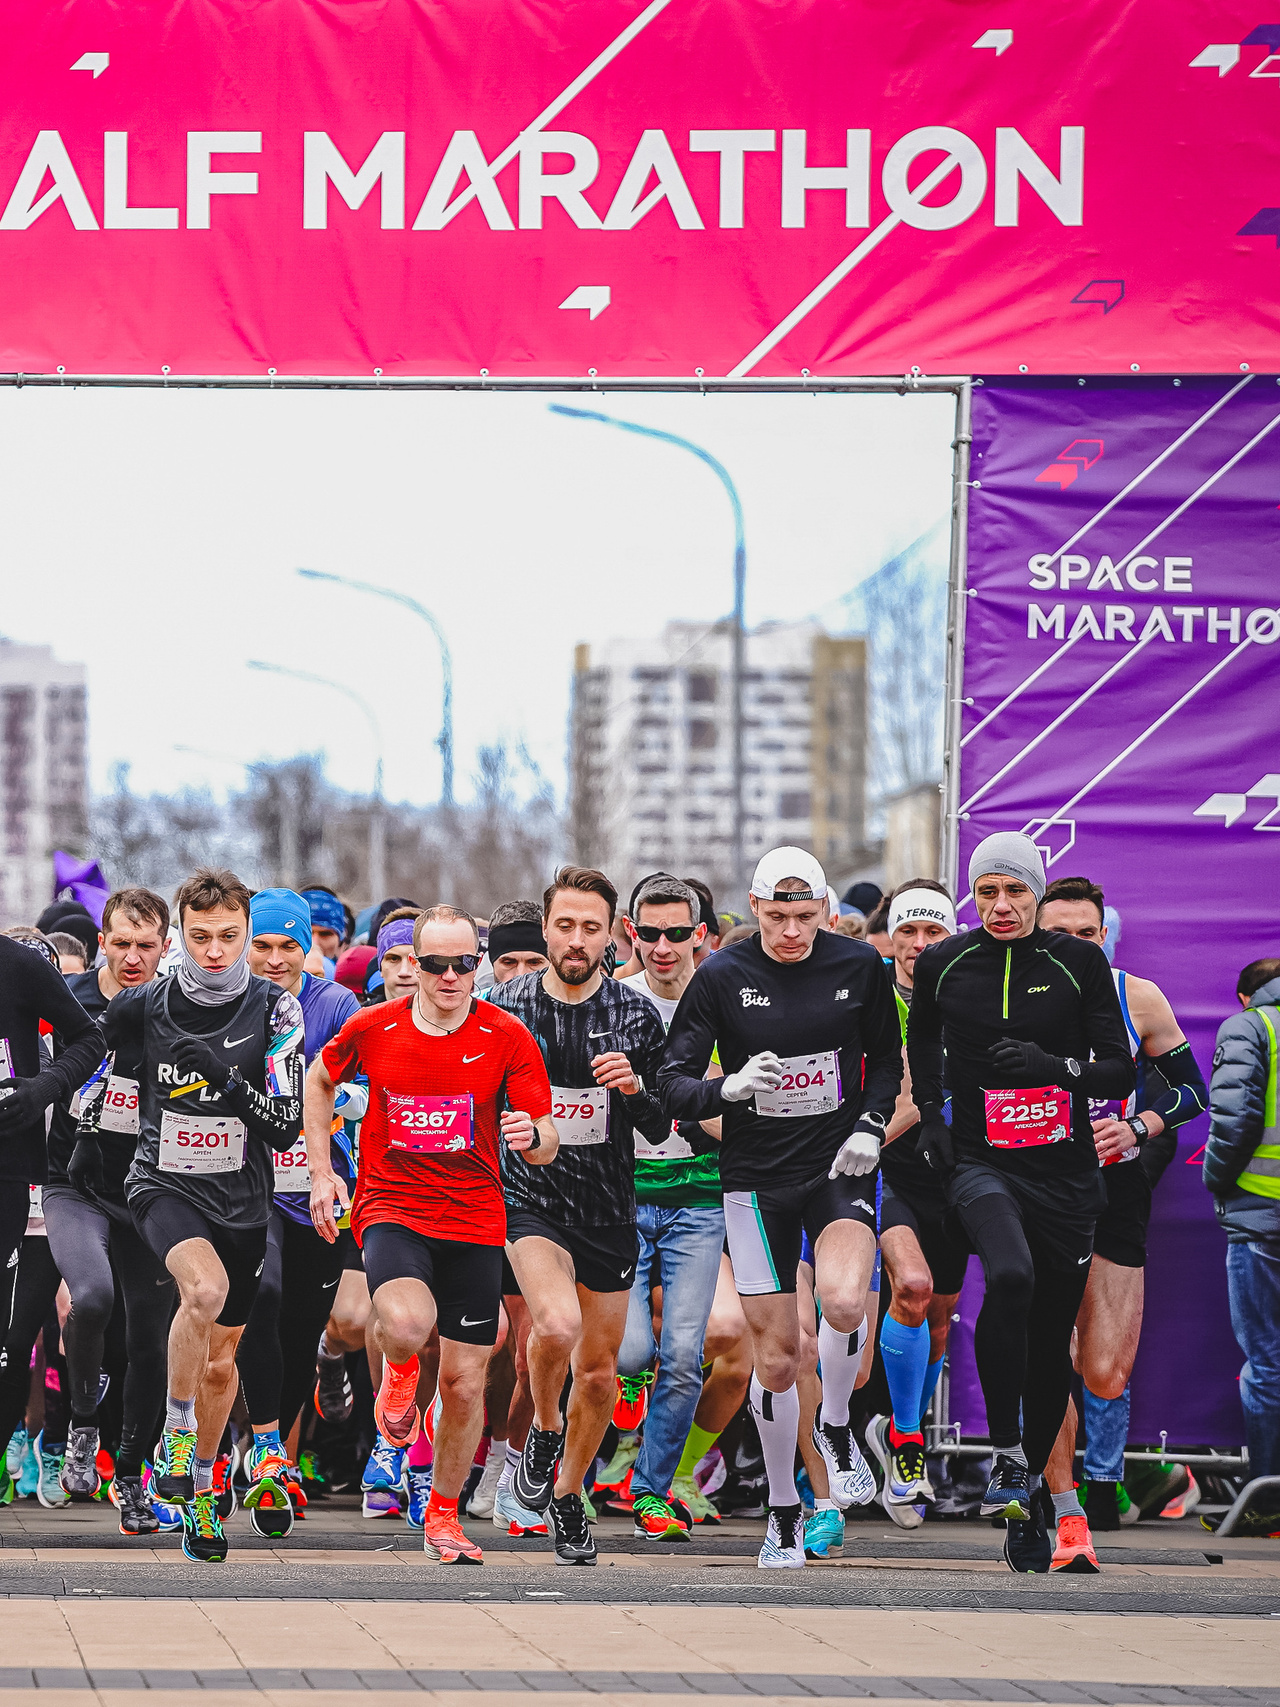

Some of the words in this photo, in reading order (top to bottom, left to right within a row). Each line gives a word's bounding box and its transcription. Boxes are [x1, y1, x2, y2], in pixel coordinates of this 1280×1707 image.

[1028, 554, 1193, 593] SPACE
[905, 908, 947, 922] TERREX
[742, 993, 771, 1007] Bite
[774, 1070, 826, 1091] 204
[786, 1090, 808, 1099] СЕРГЕЙ
[400, 1110, 458, 1128] 2367
[553, 1103, 595, 1119] 279
[1001, 1100, 1059, 1123] 2255
[1013, 1121, 1049, 1130] АЛЕКСАНДР
[176, 1130, 229, 1148] 5201
[272, 1151, 308, 1167] 182
